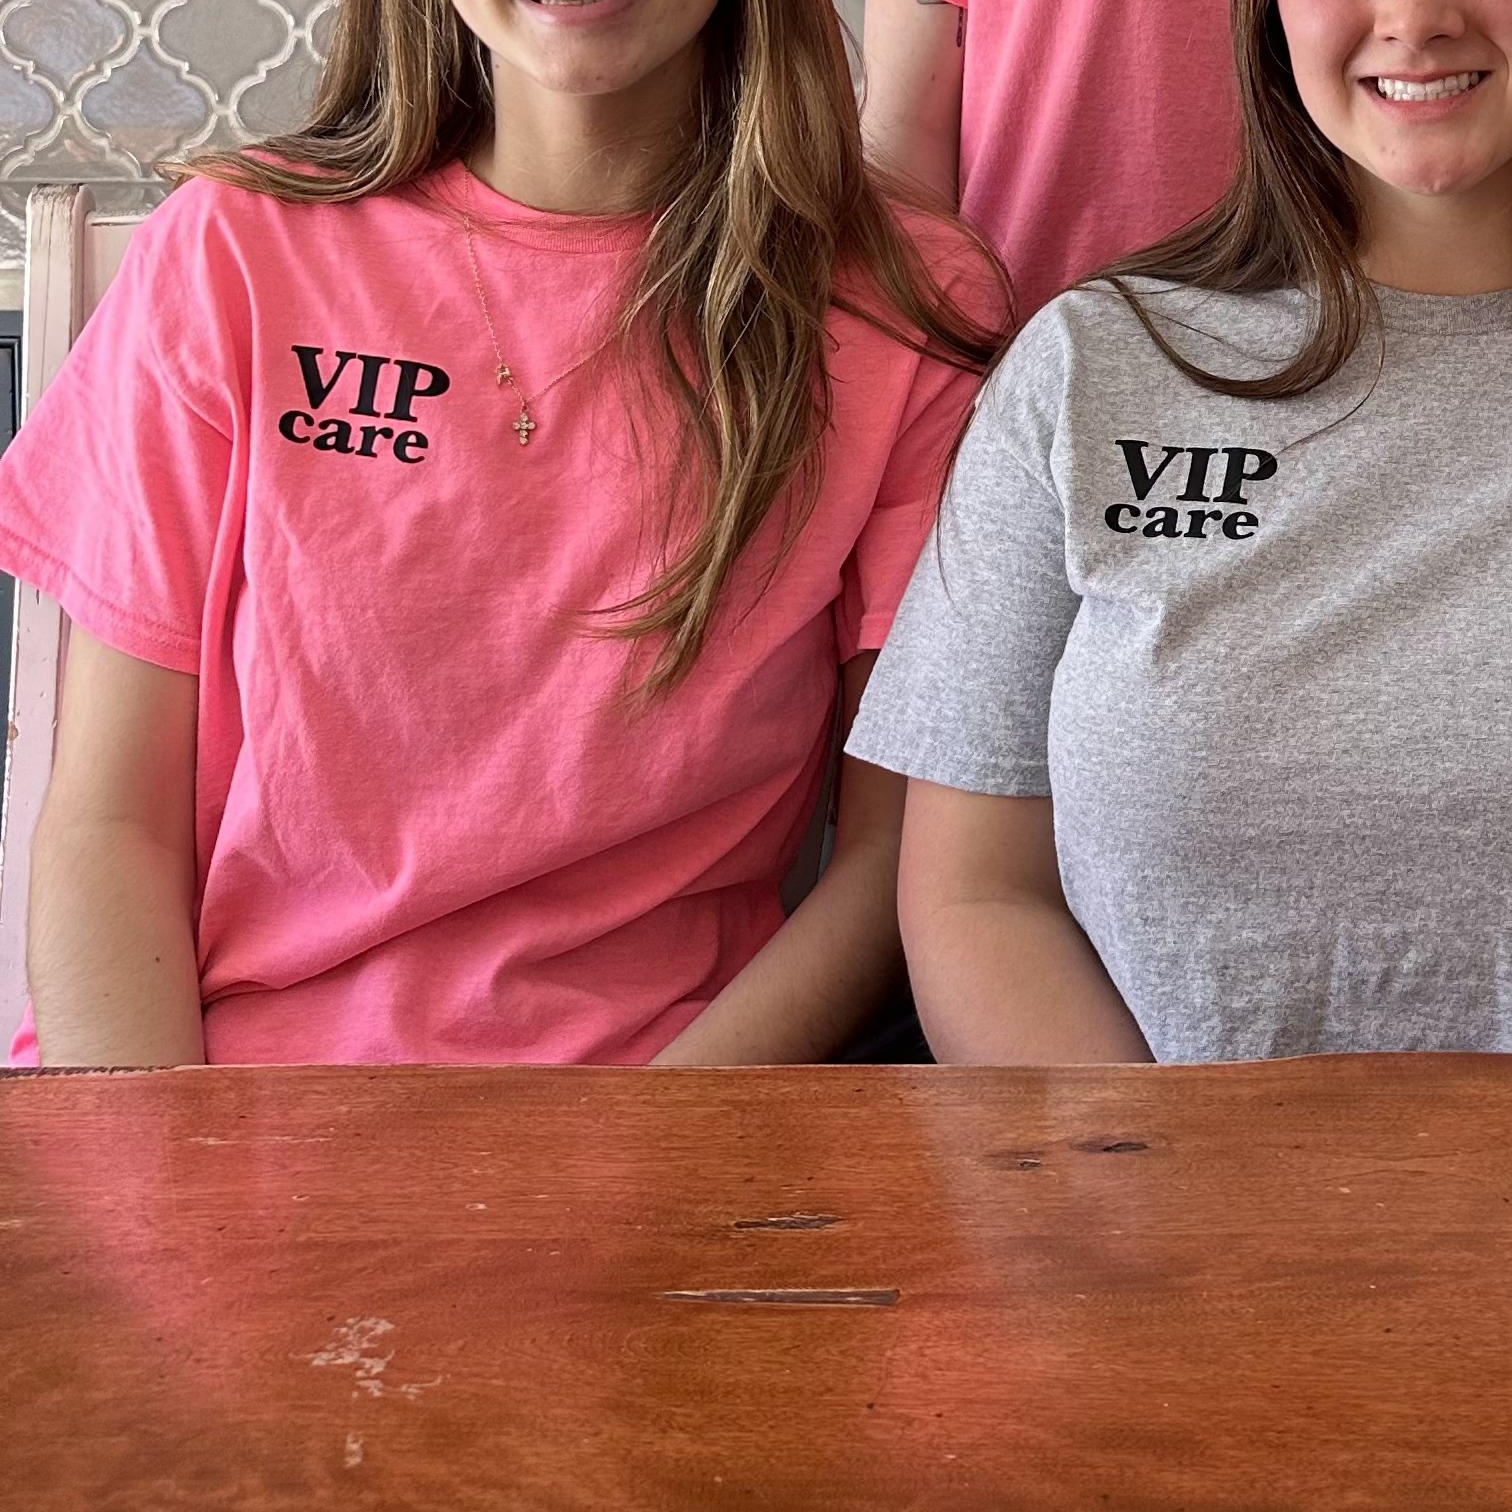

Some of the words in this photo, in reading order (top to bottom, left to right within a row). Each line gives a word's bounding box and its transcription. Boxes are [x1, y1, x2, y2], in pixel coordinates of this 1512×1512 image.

[291, 344, 450, 423] VIP
[278, 410, 429, 464] care
[1114, 439, 1278, 505] VIP
[1104, 503, 1259, 540] care
